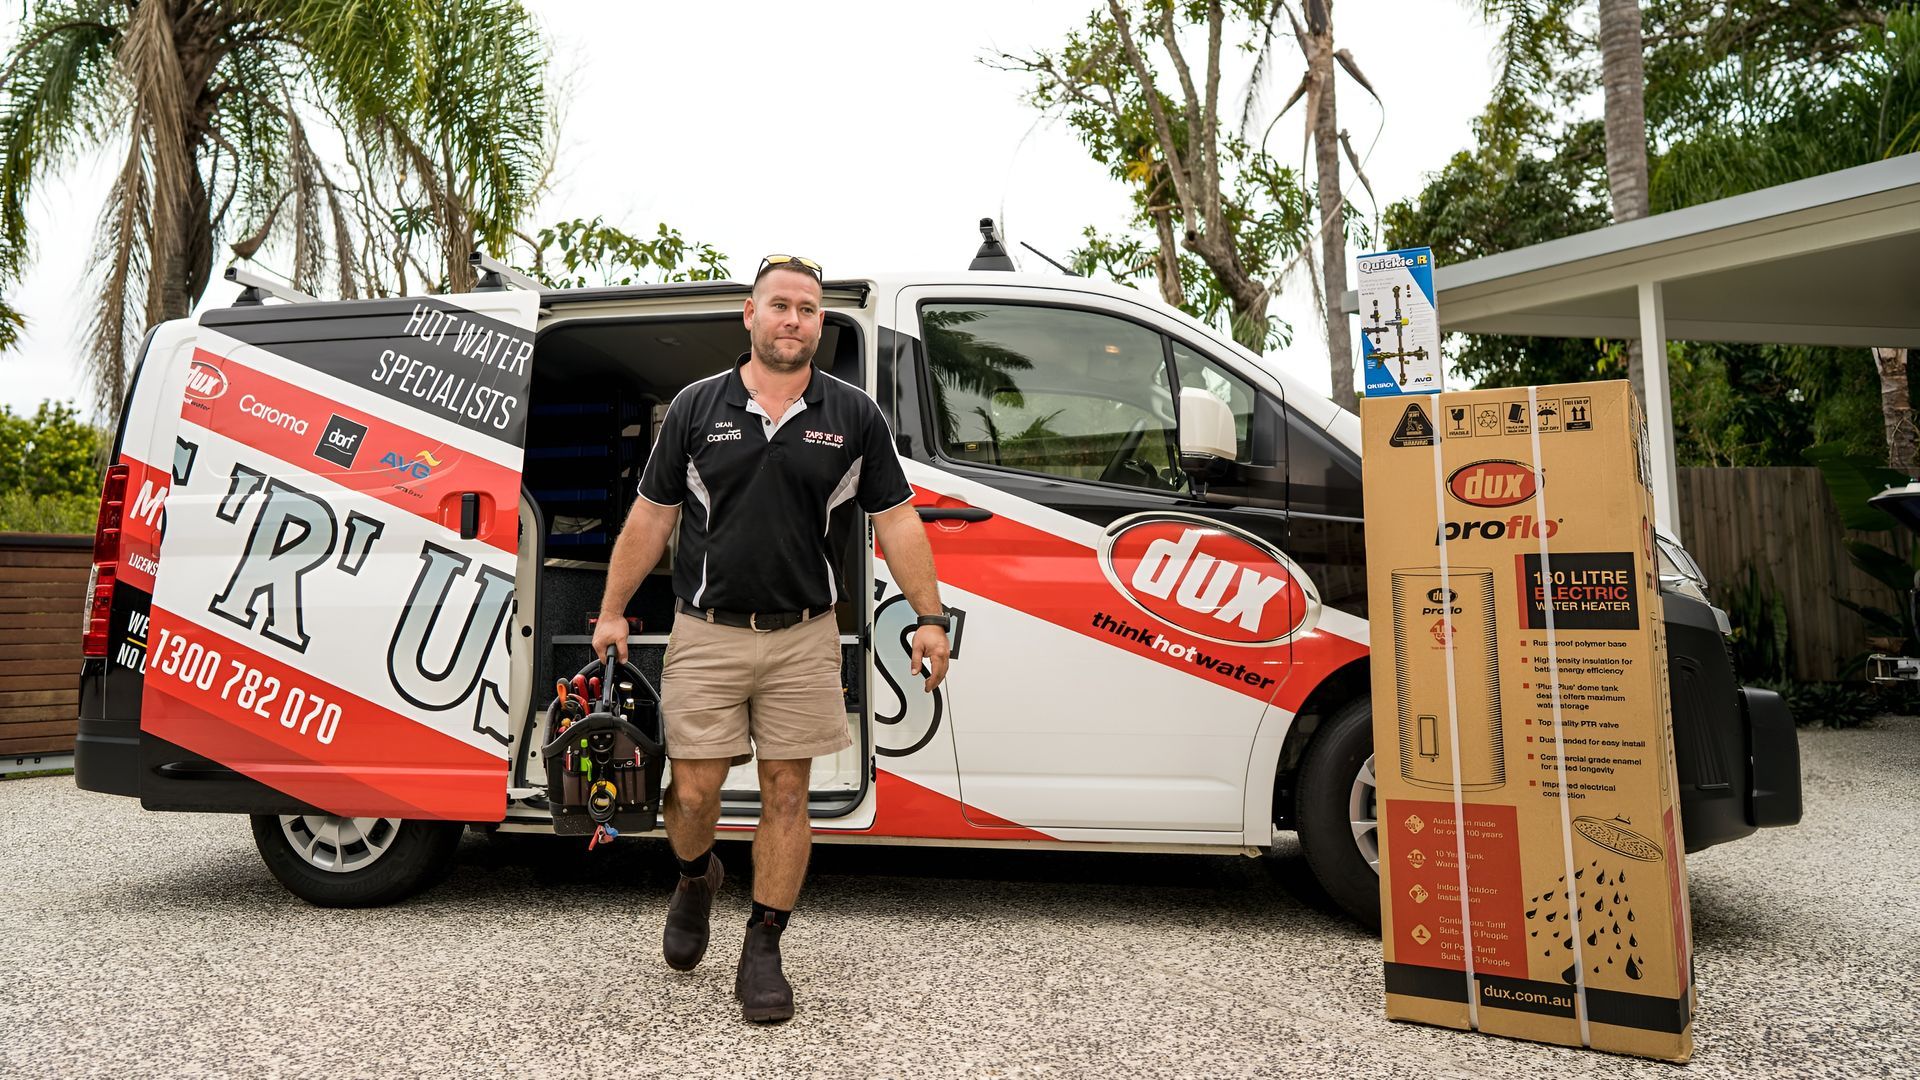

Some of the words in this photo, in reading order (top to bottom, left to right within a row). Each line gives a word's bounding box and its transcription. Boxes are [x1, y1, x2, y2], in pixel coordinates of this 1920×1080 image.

[1359, 256, 1414, 274] Quickie
[403, 303, 458, 346] HOT
[453, 320, 534, 377] WATER
[371, 349, 518, 430] SPECIALISTS
[239, 394, 309, 437] Caroma
[328, 427, 357, 449] dorf
[707, 432, 742, 442] Caroma
[805, 430, 824, 440] TAPS
[834, 434, 844, 444] US
[379, 451, 431, 480] AVG
[1464, 468, 1525, 500] dux
[1435, 515, 1559, 546] proflo
[1131, 528, 1287, 633] dux
[1534, 571, 1565, 584] 160
[1571, 570, 1628, 585] LITRE
[1534, 586, 1628, 600] ELECTRIC
[1423, 607, 1462, 615] prolo
[1582, 601, 1631, 611] HEATER
[1575, 640, 1606, 648] polymer
[116, 642, 140, 669] NO
[1091, 611, 1275, 690] thinkhotwater
[1586, 667, 1624, 675] efficiency
[150, 627, 222, 692] 1300
[220, 658, 281, 719] 782
[281, 686, 342, 746] 070
[1587, 694, 1625, 702] maximum
[1538, 719, 1552, 727] Top
[1555, 720, 1578, 728] ality
[1599, 721, 1619, 729] valve
[1602, 740, 1620, 748] easy
[1540, 754, 1586, 763] Comercial
[1588, 756, 1611, 764] grade
[1613, 757, 1642, 765] enamel
[1554, 764, 1578, 772] aed
[1580, 766, 1615, 774] longevity
[1542, 781, 1578, 789] Impred
[1580, 783, 1616, 792] electrical
[1543, 791, 1586, 799] conction
[1433, 817, 1472, 827] Austran
[1474, 820, 1496, 828] made
[1466, 829, 1479, 837] 100
[1481, 831, 1503, 839] years
[1436, 860, 1470, 869] Warray
[1437, 883, 1461, 891] Indoo
[1437, 894, 1481, 903] Installon
[1439, 916, 1484, 927] Contious
[1440, 927, 1459, 935] Suits
[1480, 931, 1508, 940] People
[1441, 941, 1452, 949] Off
[1455, 943, 1473, 951] Pe
[1441, 952, 1460, 960] Suits
[1482, 957, 1511, 967] People
[1484, 985, 1572, 1008] dux.com.au
